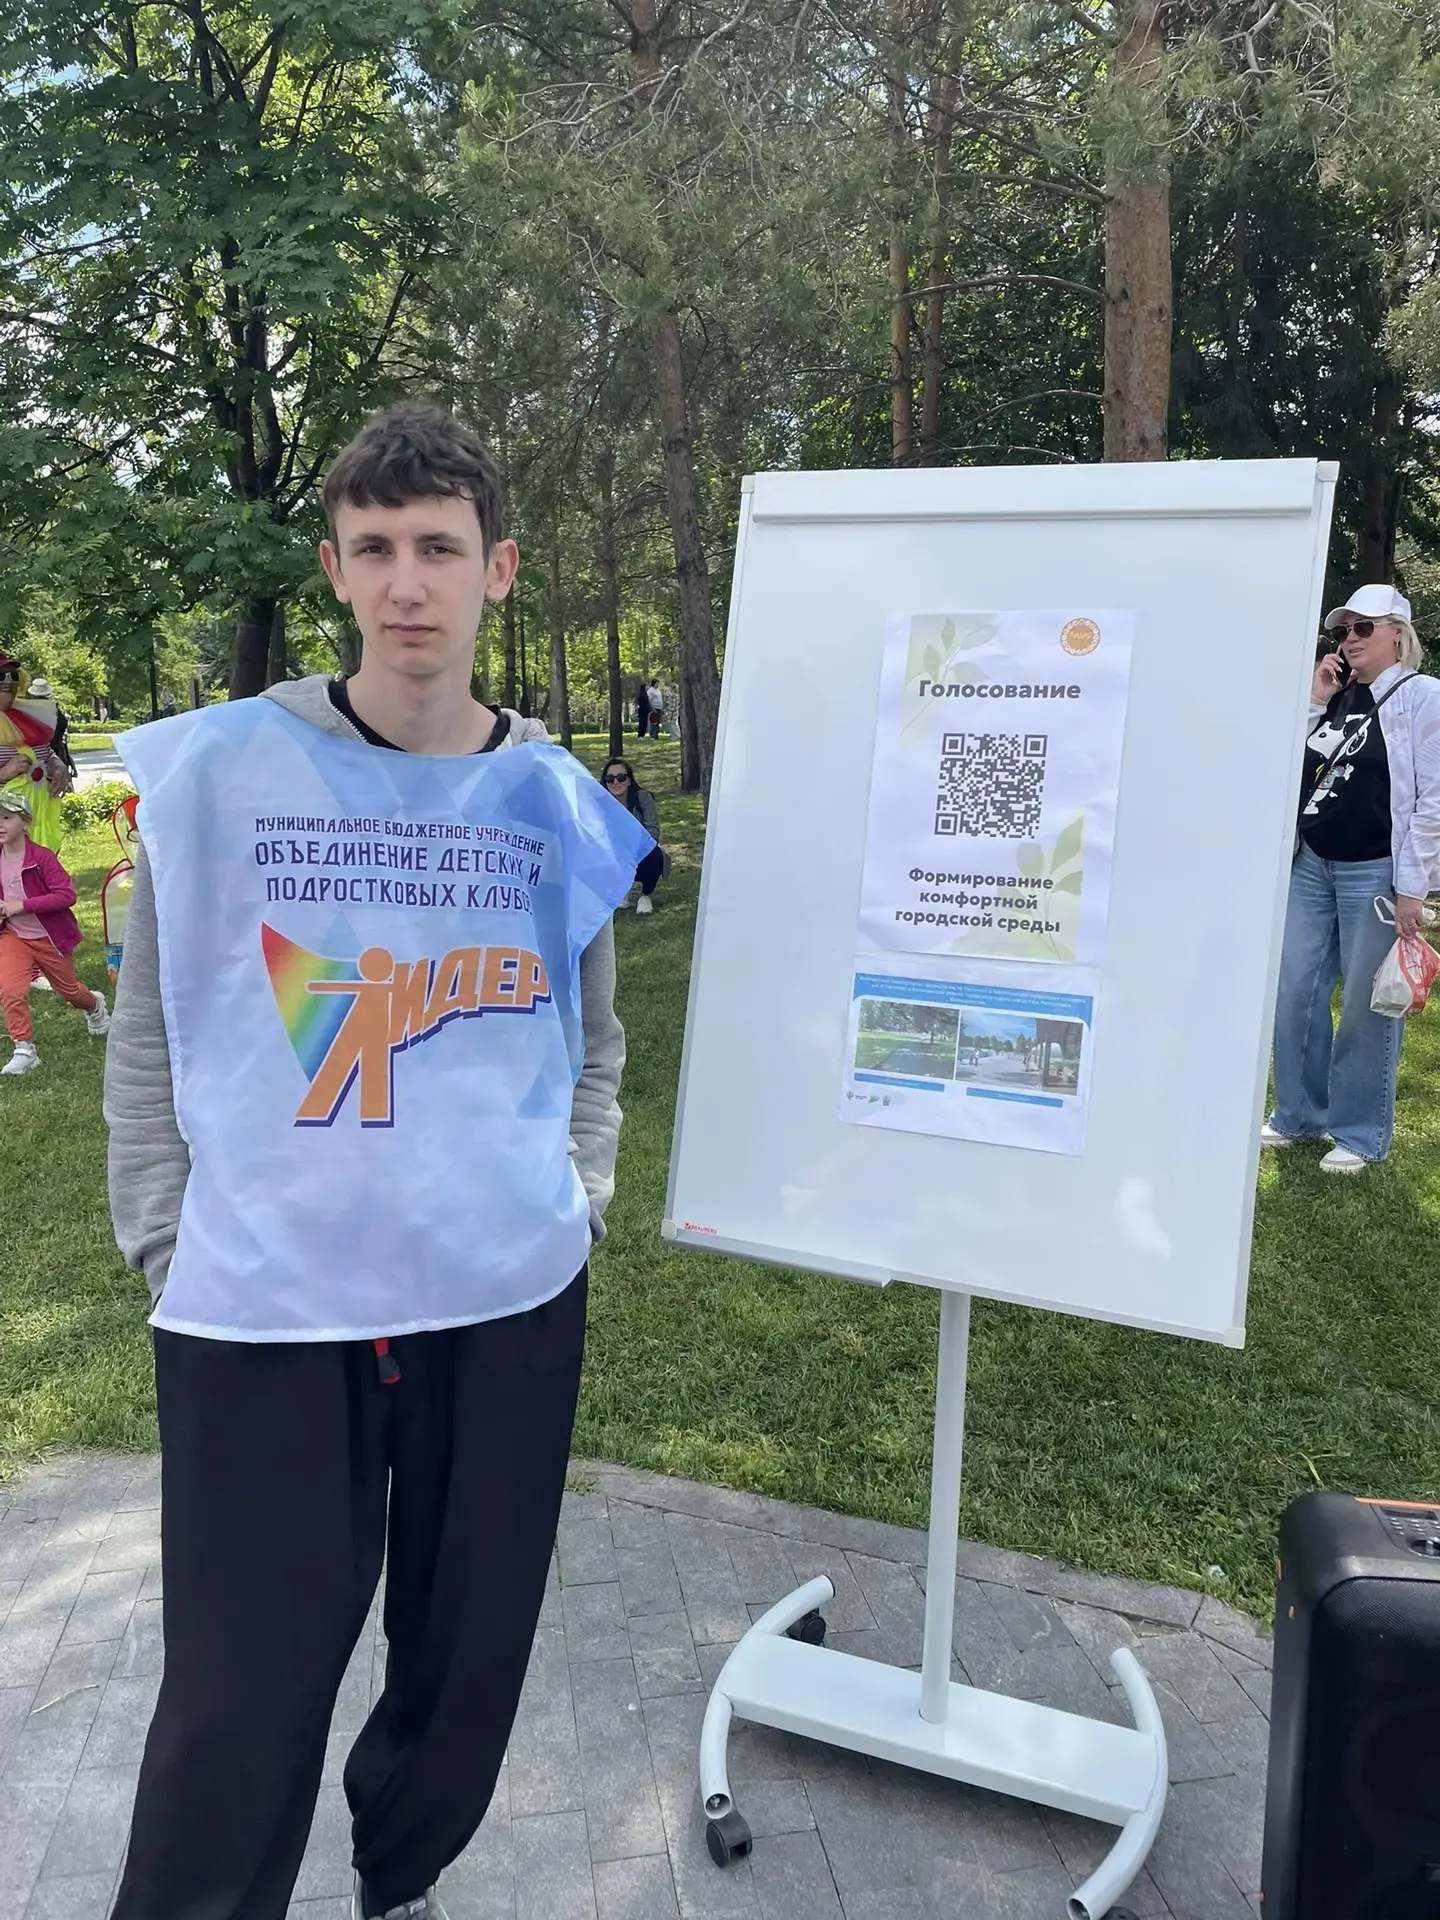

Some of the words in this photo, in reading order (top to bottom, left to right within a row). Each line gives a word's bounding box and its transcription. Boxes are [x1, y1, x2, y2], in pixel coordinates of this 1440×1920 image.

[919, 680, 1081, 699] Голосование
[255, 816, 380, 833] МУНИЦИПАЛЬНОЕ
[384, 821, 471, 840] БЮДЖЕТНОЕ
[475, 826, 545, 856] УЧРЕЖДЕНИЕ
[255, 840, 428, 871] ОБЪЕДИНЕНИЕ
[437, 848, 525, 880] ДЕТСКИХ
[528, 862, 541, 886] И
[908, 867, 1053, 889] Формирование
[266, 876, 457, 907] ПОДРОСТКОВЫХ
[466, 883, 532, 915] КЛУБО
[919, 891, 1038, 910] комфортной
[895, 909, 993, 929] городской
[997, 917, 1060, 933] среды
[293, 946, 552, 1128] ЛИДЕР
